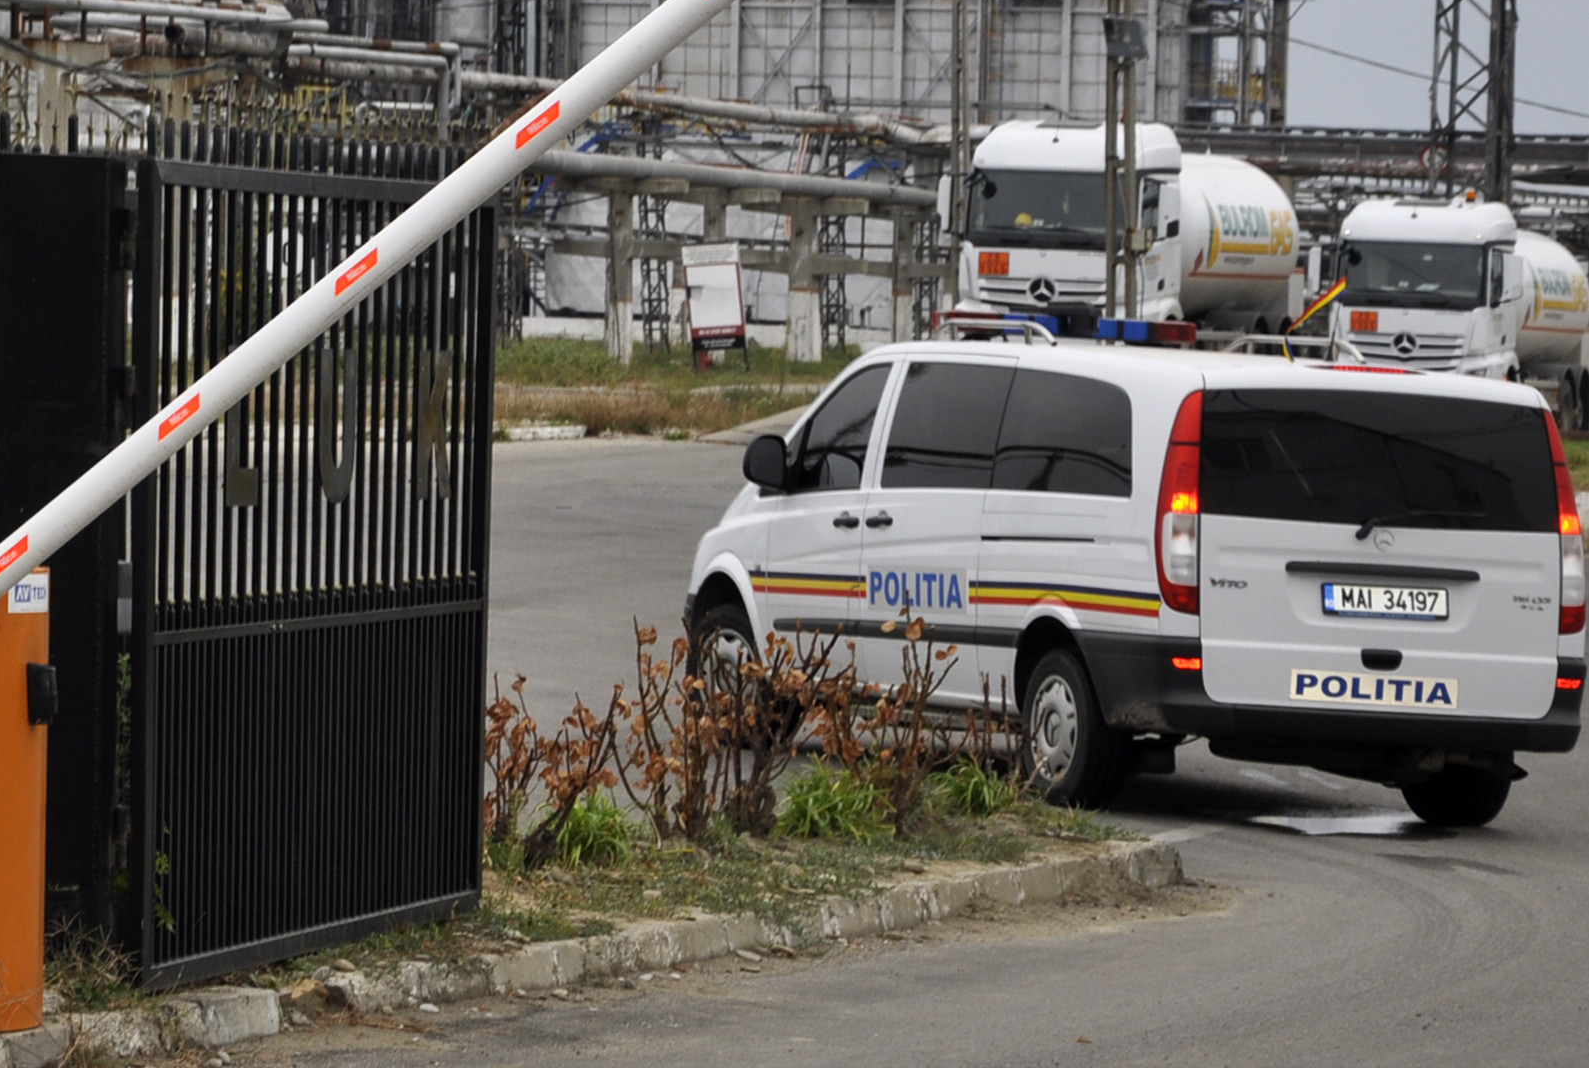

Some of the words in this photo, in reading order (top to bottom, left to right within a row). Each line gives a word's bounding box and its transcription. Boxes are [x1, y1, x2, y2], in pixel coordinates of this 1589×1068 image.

[870, 571, 963, 609] POLITIA
[1341, 587, 1372, 609] MAI
[1383, 590, 1439, 612] 34197
[1295, 673, 1453, 705] POLITIA
